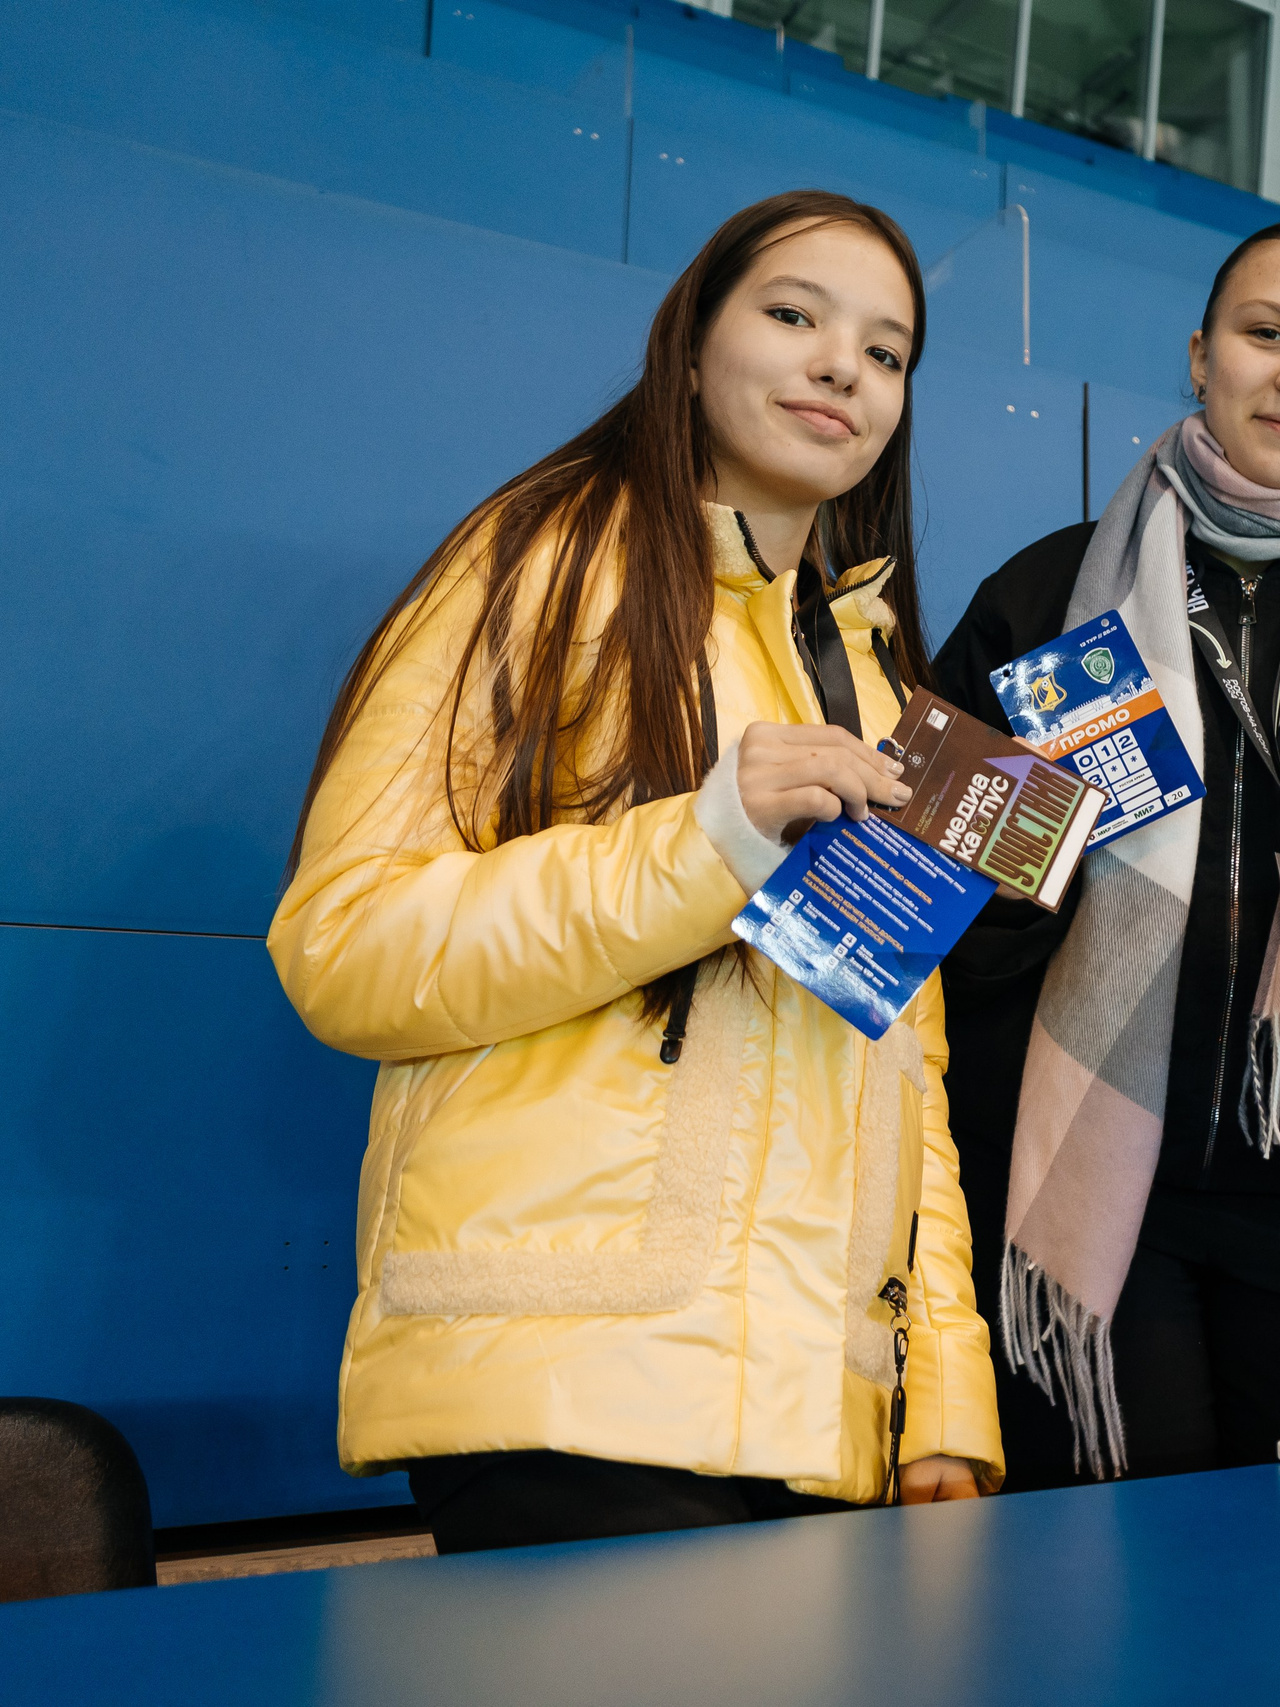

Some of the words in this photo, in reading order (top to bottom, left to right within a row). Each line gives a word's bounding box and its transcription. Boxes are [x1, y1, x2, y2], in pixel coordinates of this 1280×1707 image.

[1058, 706, 1132, 752] ПРОМО
[1077, 753, 1095, 769] 0
[1100, 745, 1110, 758] 1
[1117, 733, 1133, 749] 2
[939, 771, 991, 853] медиа
[984, 761, 1080, 889] УЧАСТНИК
[1133, 803, 1156, 819] МИР
[1171, 790, 1184, 800] 20
